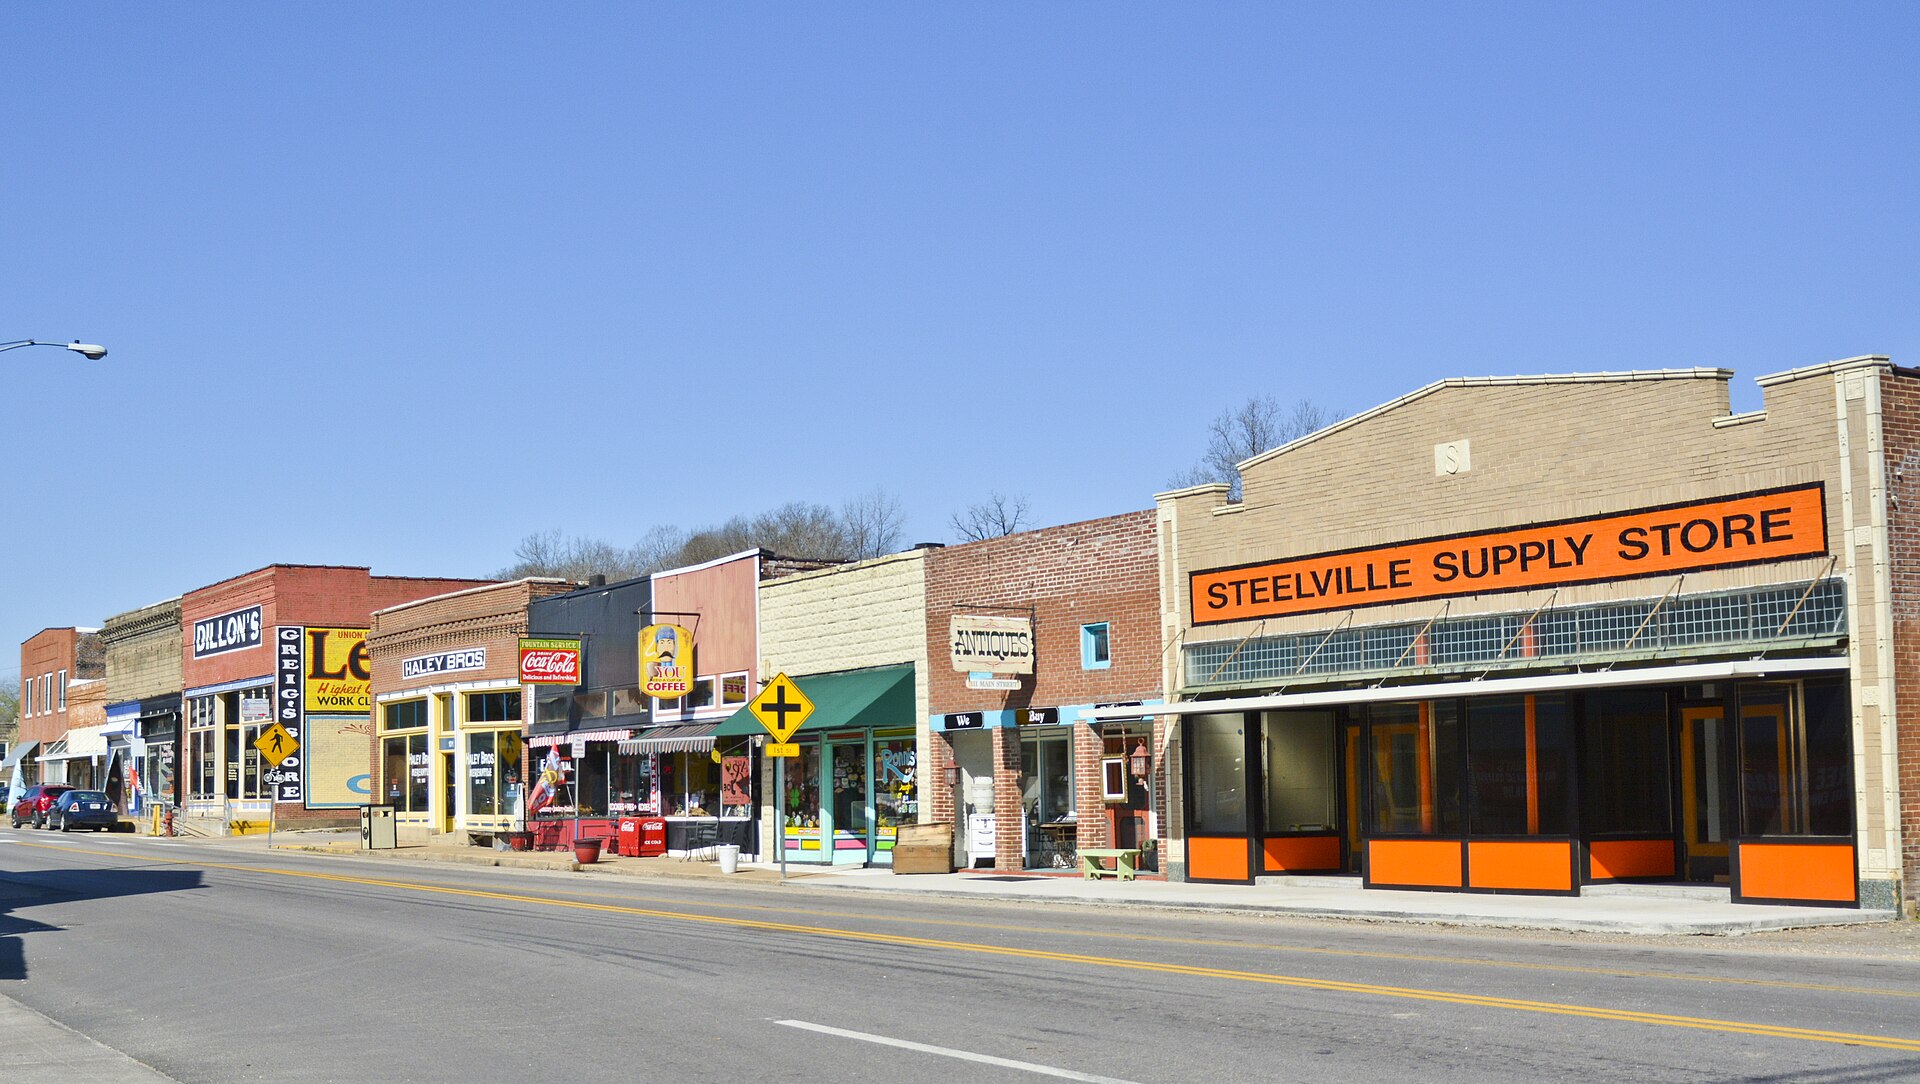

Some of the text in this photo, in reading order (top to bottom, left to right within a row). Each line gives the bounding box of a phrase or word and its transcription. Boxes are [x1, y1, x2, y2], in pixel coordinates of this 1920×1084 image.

[1207, 507, 1794, 609] STEELVILLE SUPPLY STORE
[196, 611, 260, 652] DILLON'S
[338, 631, 362, 639] UNION
[955, 630, 1029, 661] ANTIQUES
[405, 656, 444, 676] HALEY
[654, 666, 686, 678] YOU
[280, 629, 300, 719] GREIG'S
[553, 674, 577, 682] Refreshing
[647, 682, 686, 691] COFFEE
[980, 680, 995, 688] MAIN
[317, 696, 354, 706] WORK
[956, 715, 970, 726] We
[1029, 711, 1045, 723] Buy
